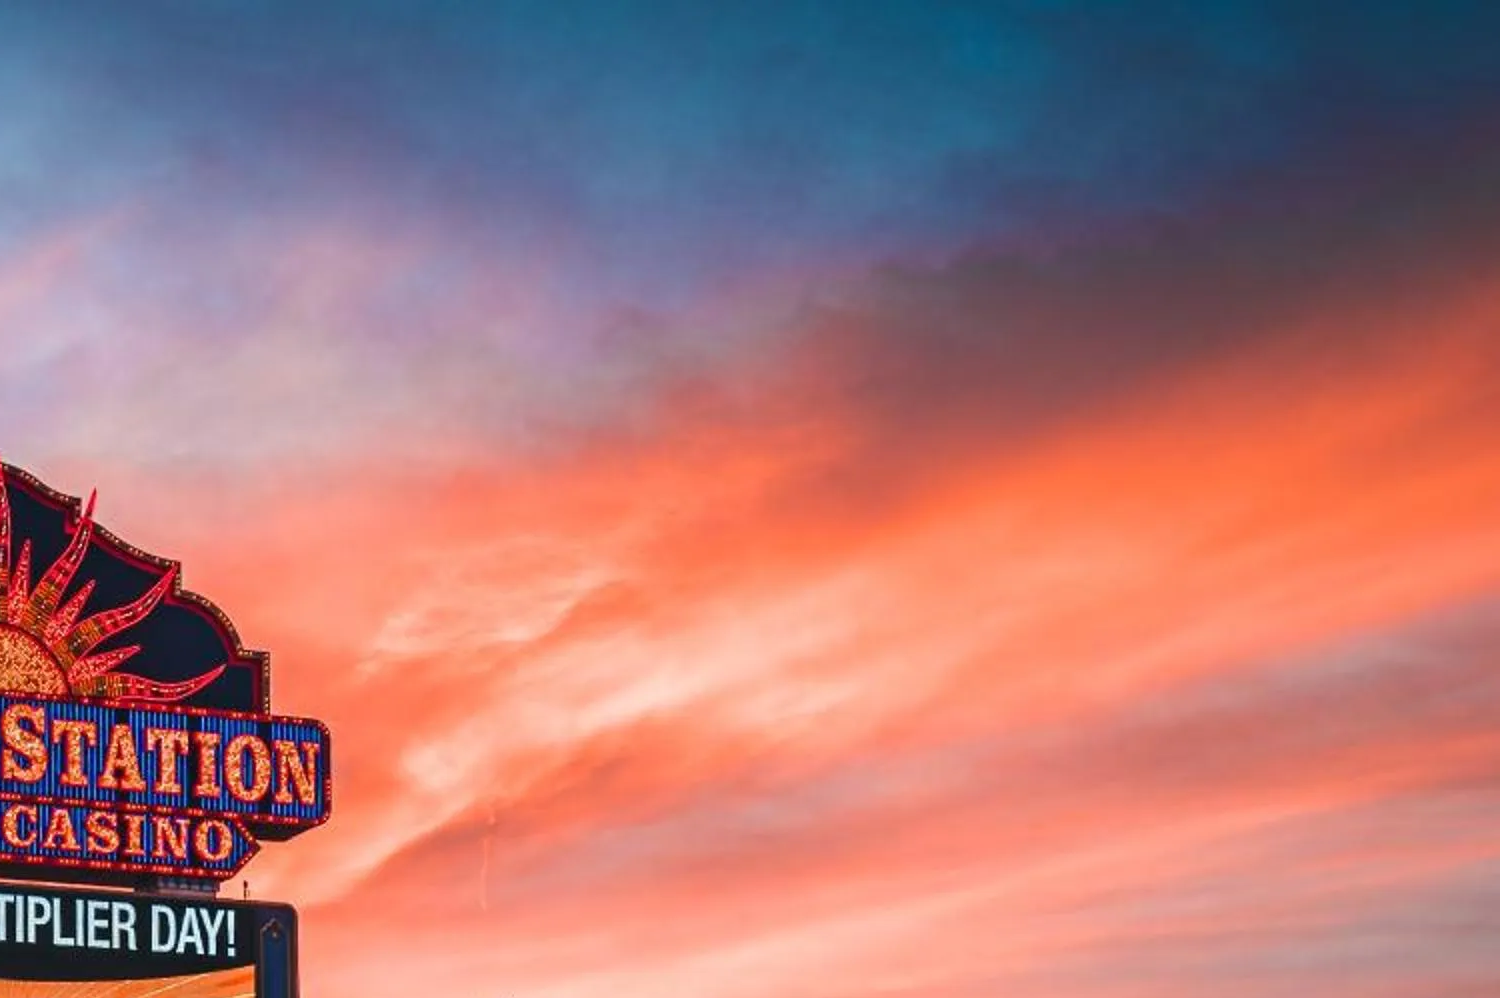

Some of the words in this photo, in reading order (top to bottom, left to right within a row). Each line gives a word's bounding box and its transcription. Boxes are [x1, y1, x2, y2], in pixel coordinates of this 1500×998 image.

[2, 702, 321, 805] STATION
[3, 803, 232, 860] CASINO
[151, 905, 238, 956] DAY!
